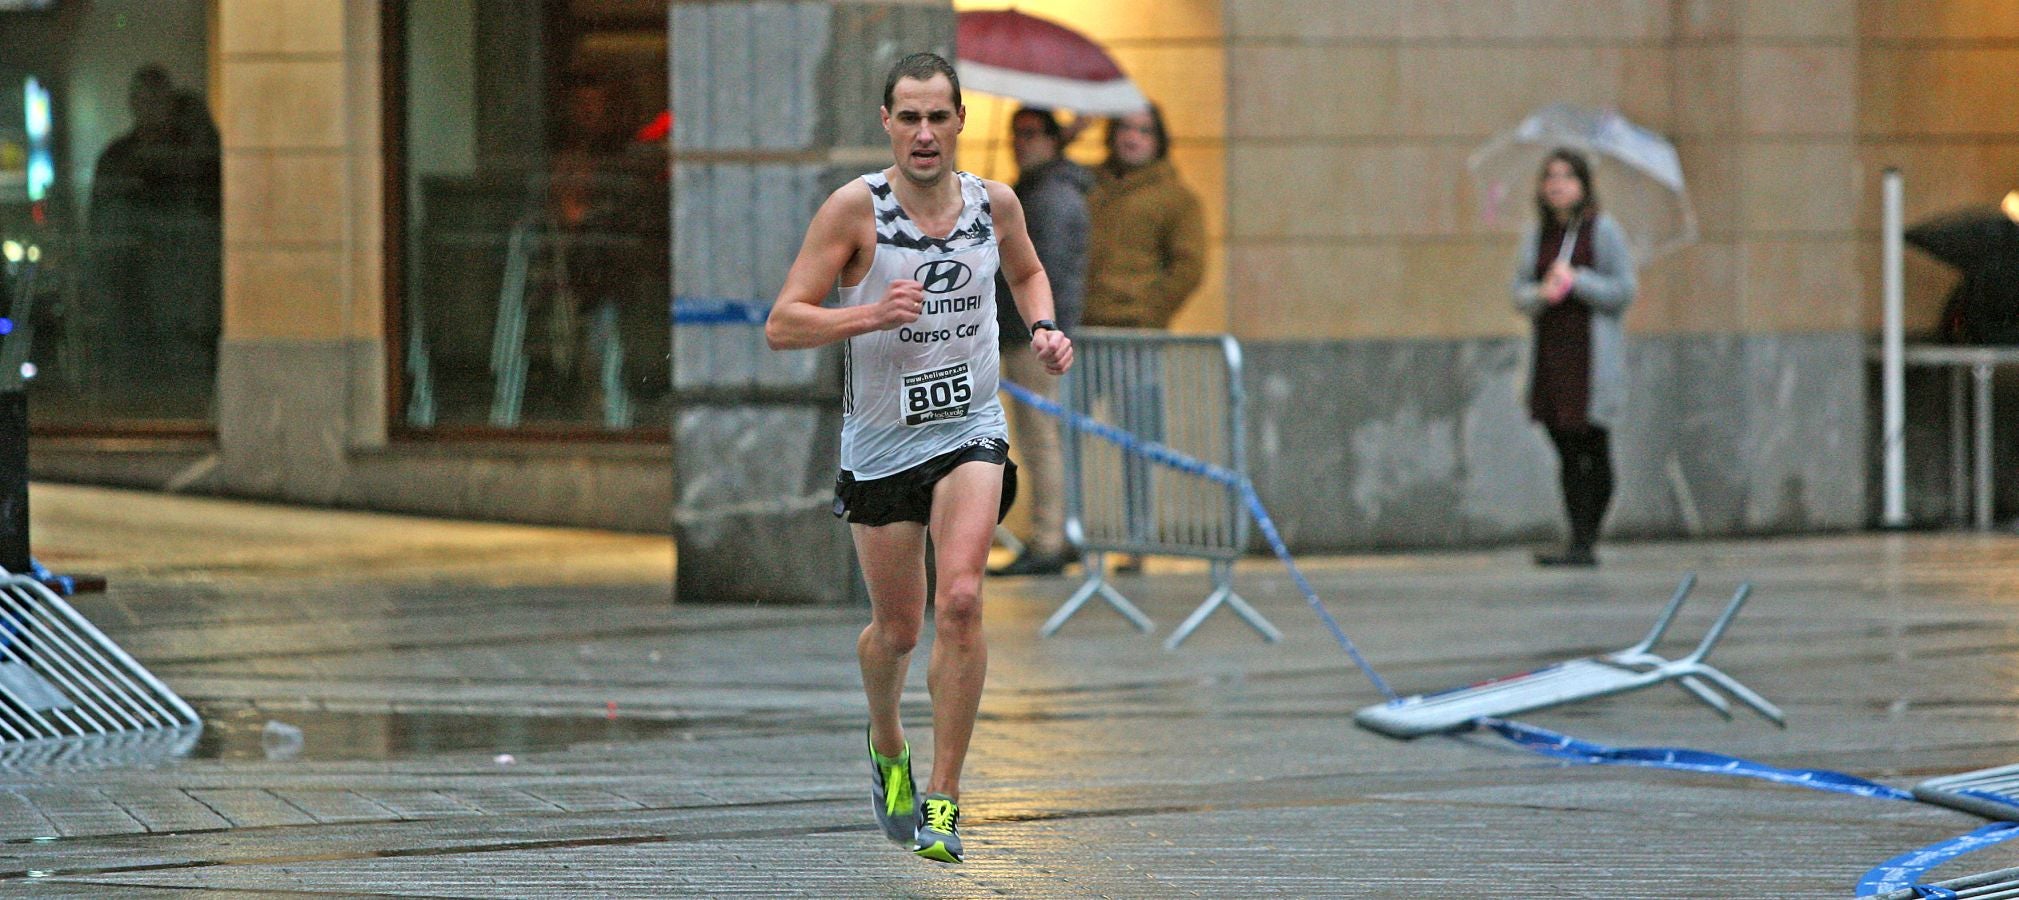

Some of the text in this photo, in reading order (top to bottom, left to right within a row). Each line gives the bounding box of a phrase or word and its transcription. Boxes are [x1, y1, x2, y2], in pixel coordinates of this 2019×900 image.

[919, 295, 982, 315] YUNDAI
[899, 323, 980, 343] Oarso Car
[908, 376, 972, 412] 805
